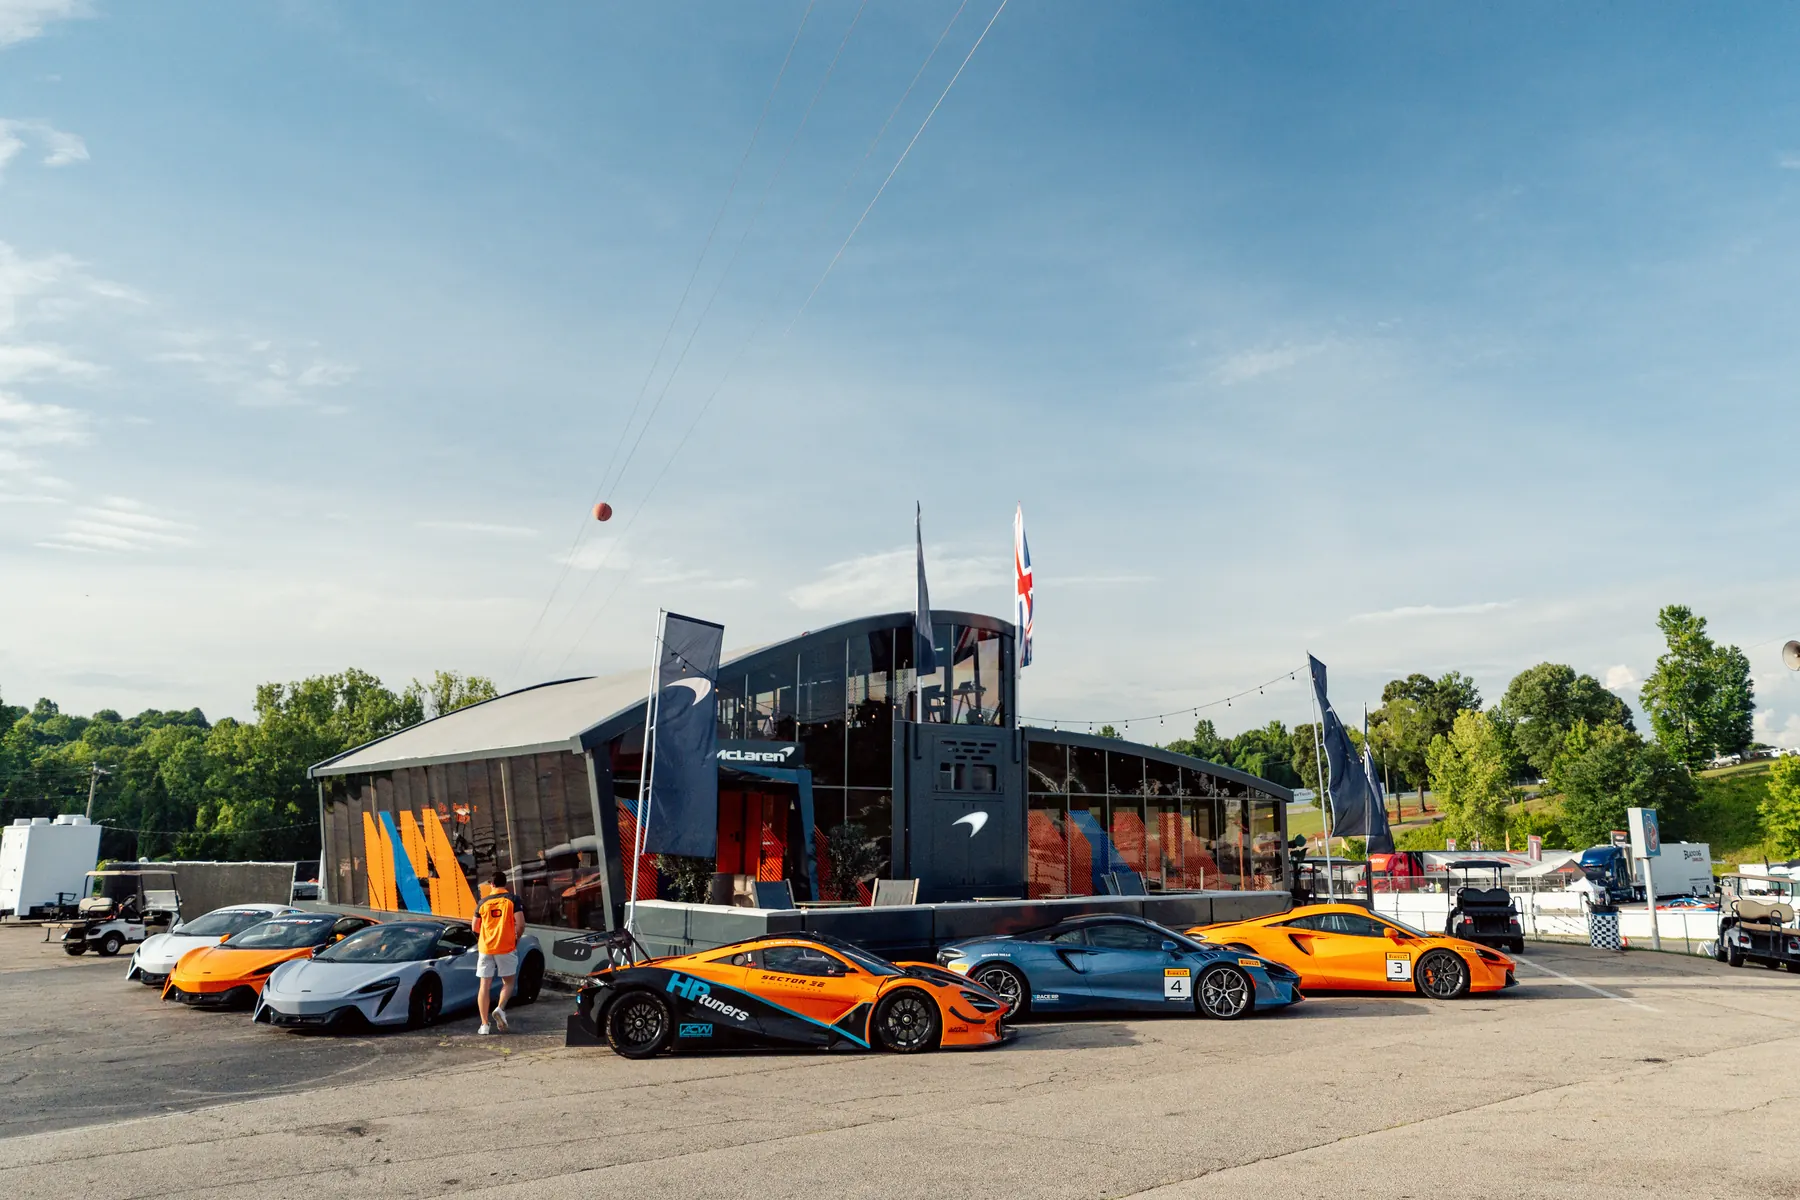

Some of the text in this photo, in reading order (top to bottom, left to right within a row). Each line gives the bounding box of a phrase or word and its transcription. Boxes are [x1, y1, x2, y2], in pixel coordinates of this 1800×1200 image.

[1393, 962, 1403, 974] 3
[761, 975, 807, 985] SECTOR
[1170, 980, 1182, 993] 4
